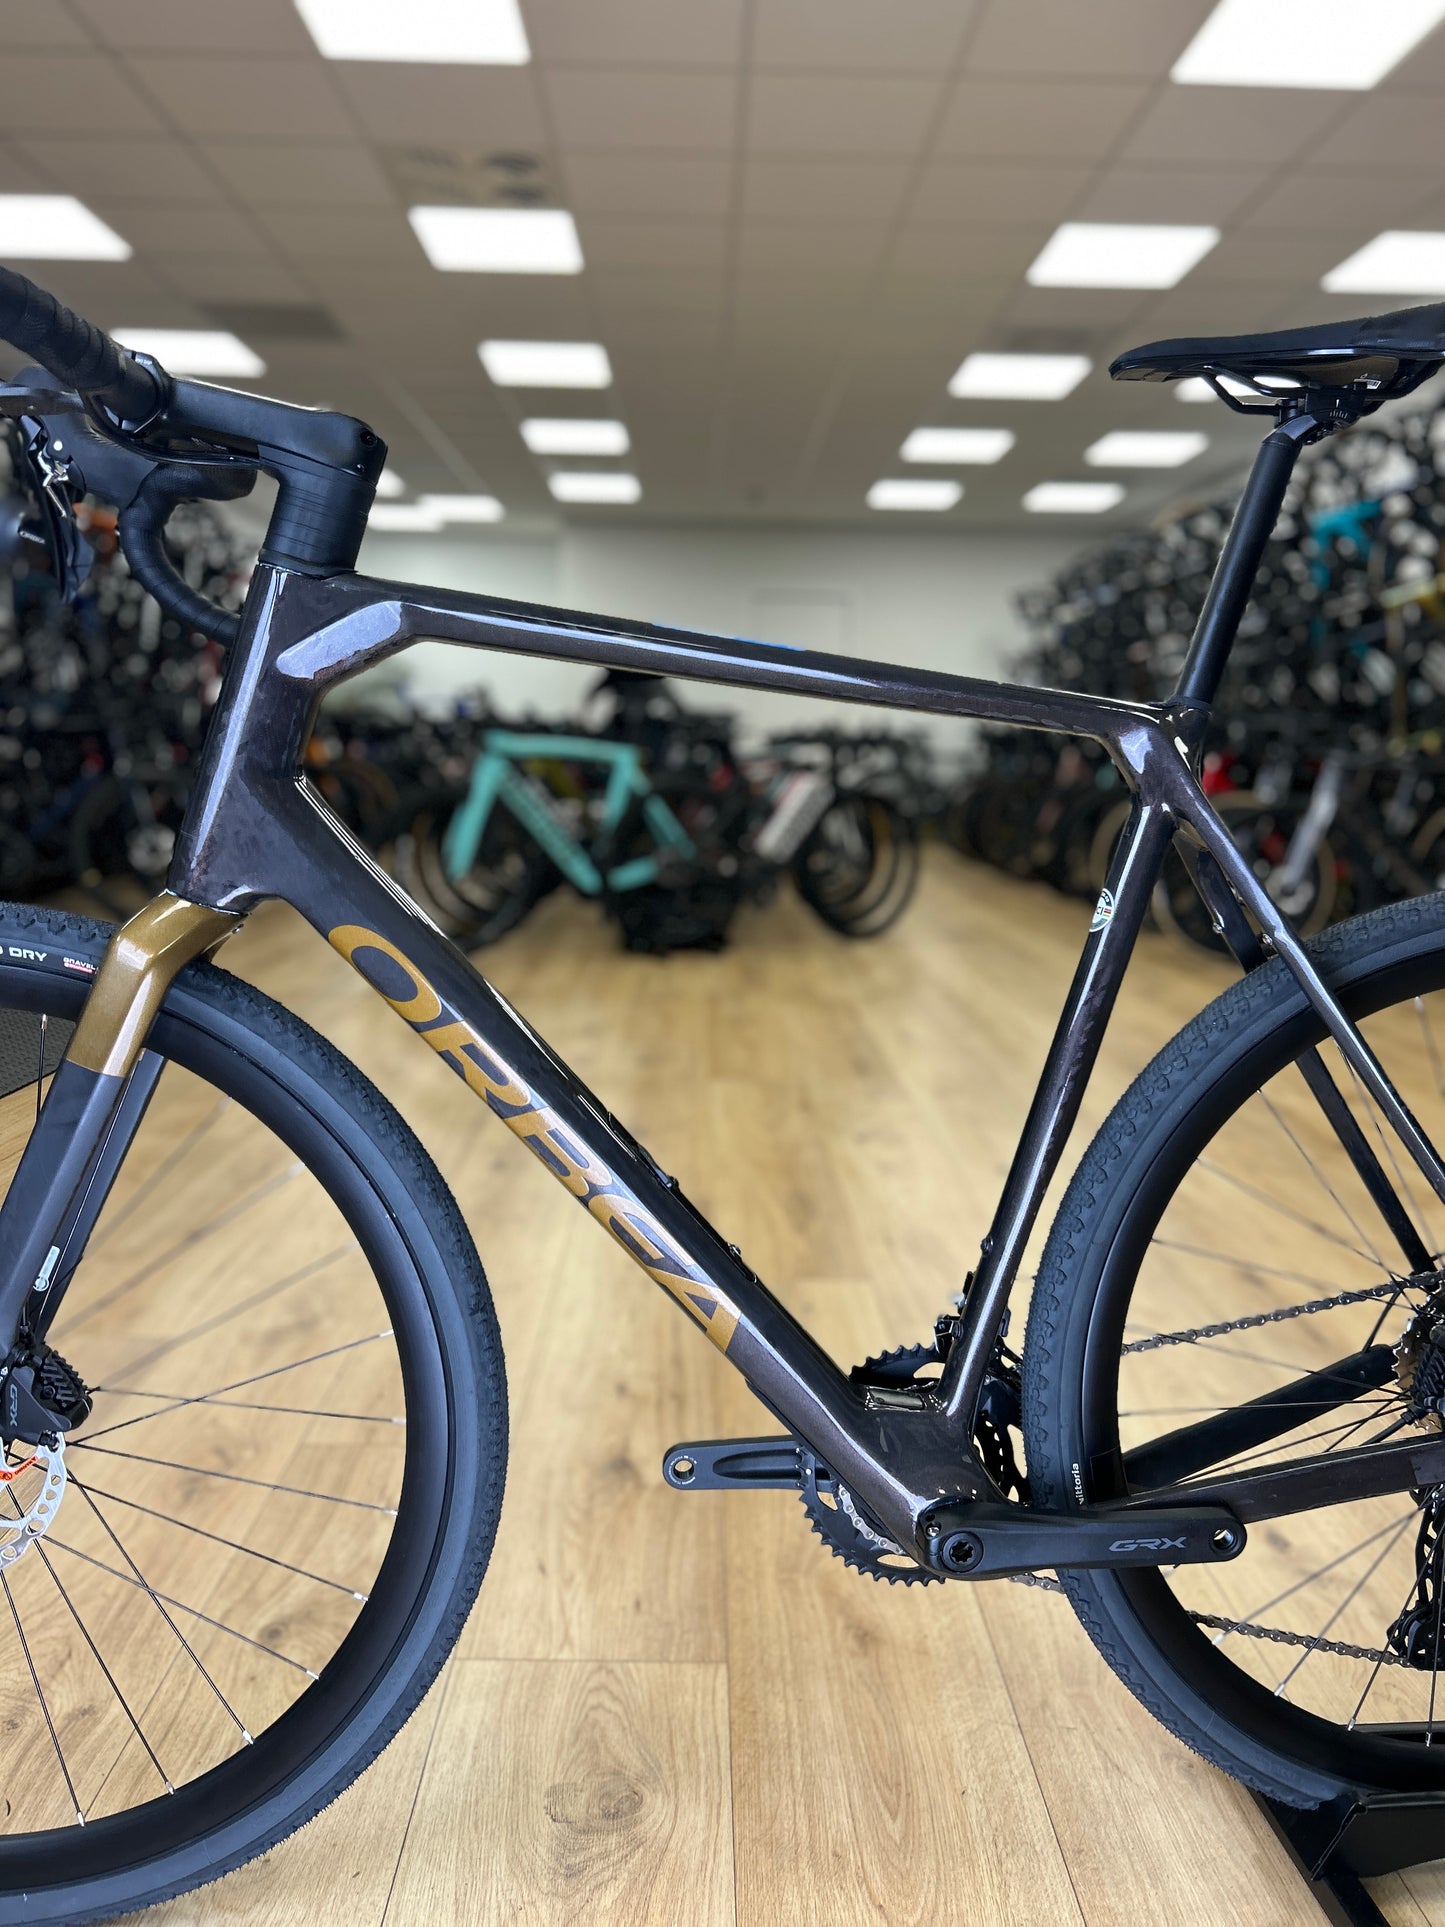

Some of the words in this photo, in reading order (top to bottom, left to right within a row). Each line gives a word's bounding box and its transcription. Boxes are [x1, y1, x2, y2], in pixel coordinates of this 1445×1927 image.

[9, 946, 47, 962] DRY
[328, 924, 741, 1355] ORBEA
[9, 1383, 18, 1428] GRX
[1071, 1463, 1085, 1505] vittoria
[1108, 1536, 1187, 1552] GRX
